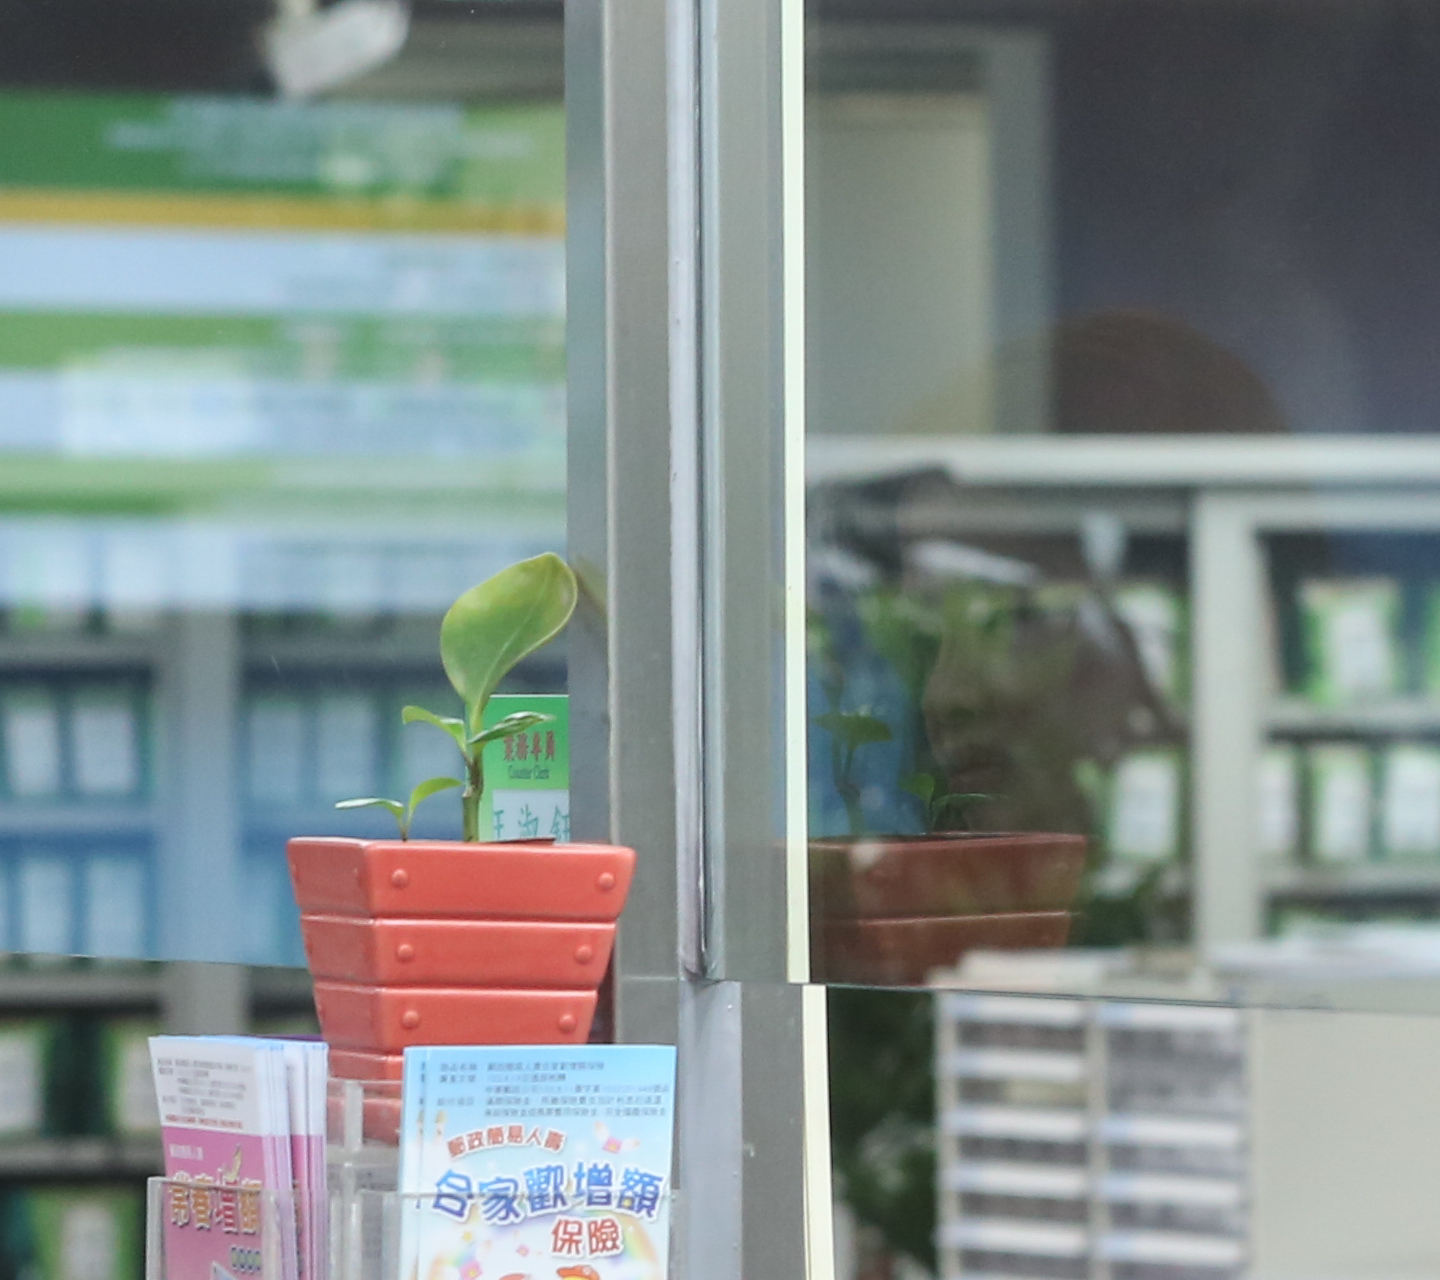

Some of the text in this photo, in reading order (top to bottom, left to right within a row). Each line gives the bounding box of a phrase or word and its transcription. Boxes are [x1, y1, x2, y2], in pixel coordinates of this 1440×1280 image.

[432, 1161, 665, 1222] 合家歡增額
[550, 1217, 623, 1257] 保險
